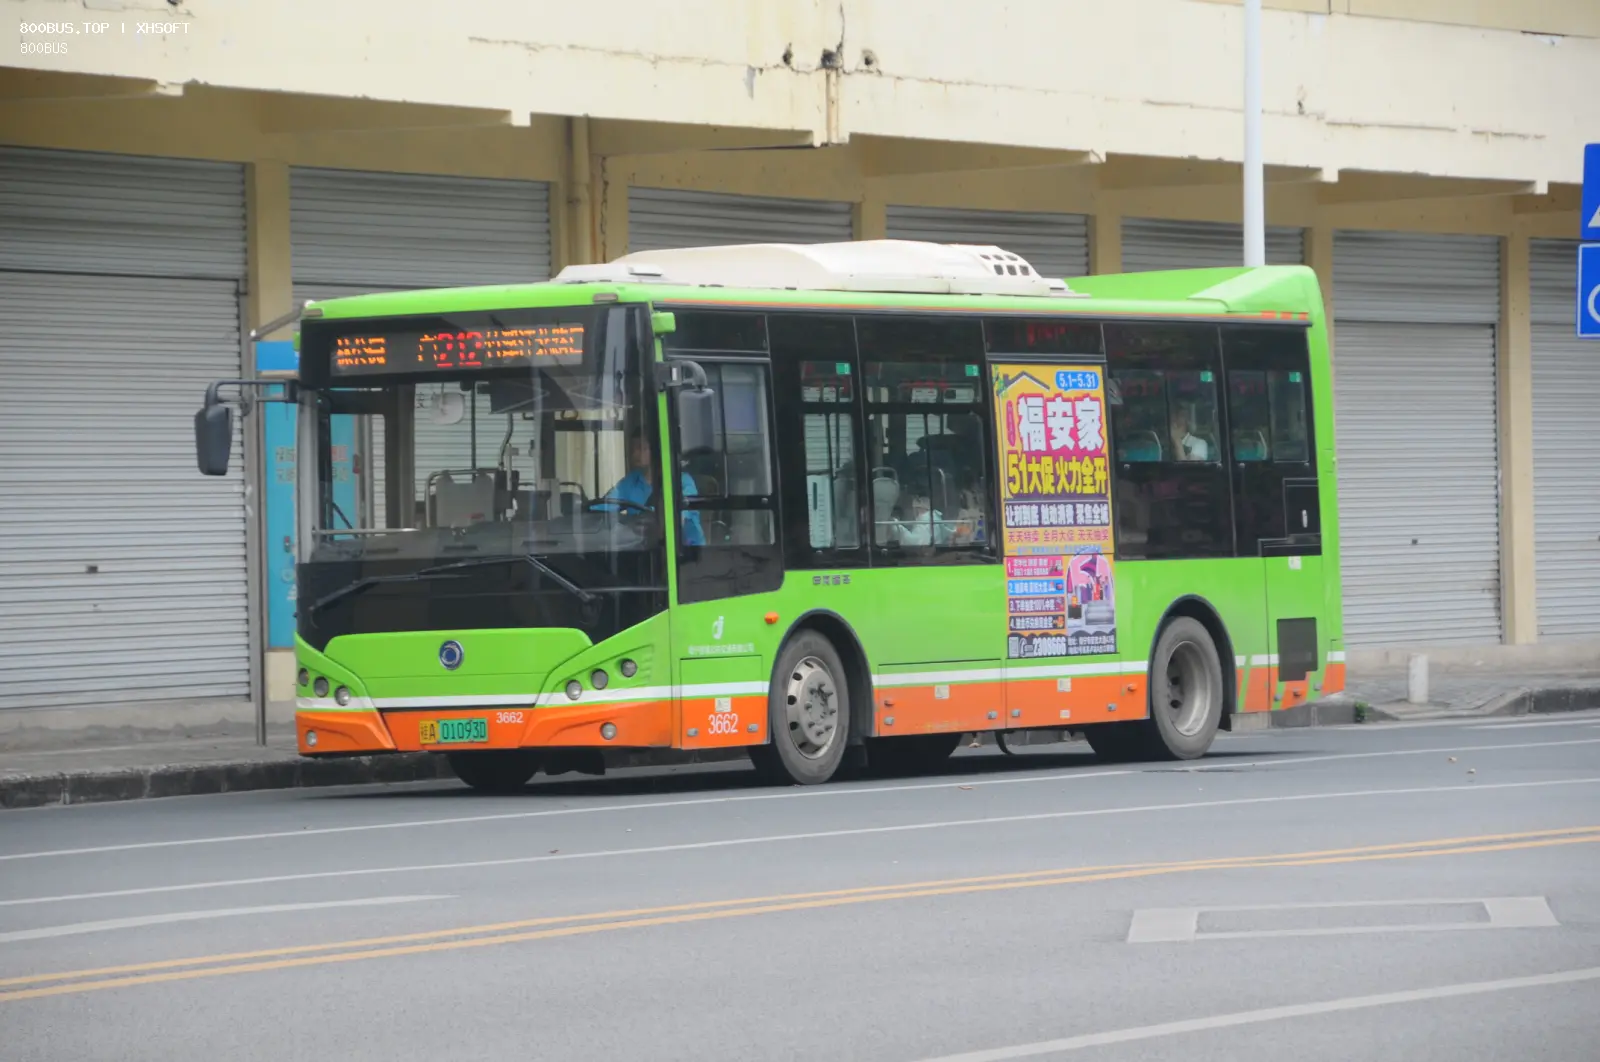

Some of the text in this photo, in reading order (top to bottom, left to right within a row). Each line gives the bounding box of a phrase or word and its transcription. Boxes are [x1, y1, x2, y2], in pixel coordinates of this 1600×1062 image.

[1058, 372, 1097, 388] 5.1-5.31
[1017, 395, 1104, 452] 福安家
[496, 711, 524, 724] 3662
[708, 713, 739, 734] 3662
